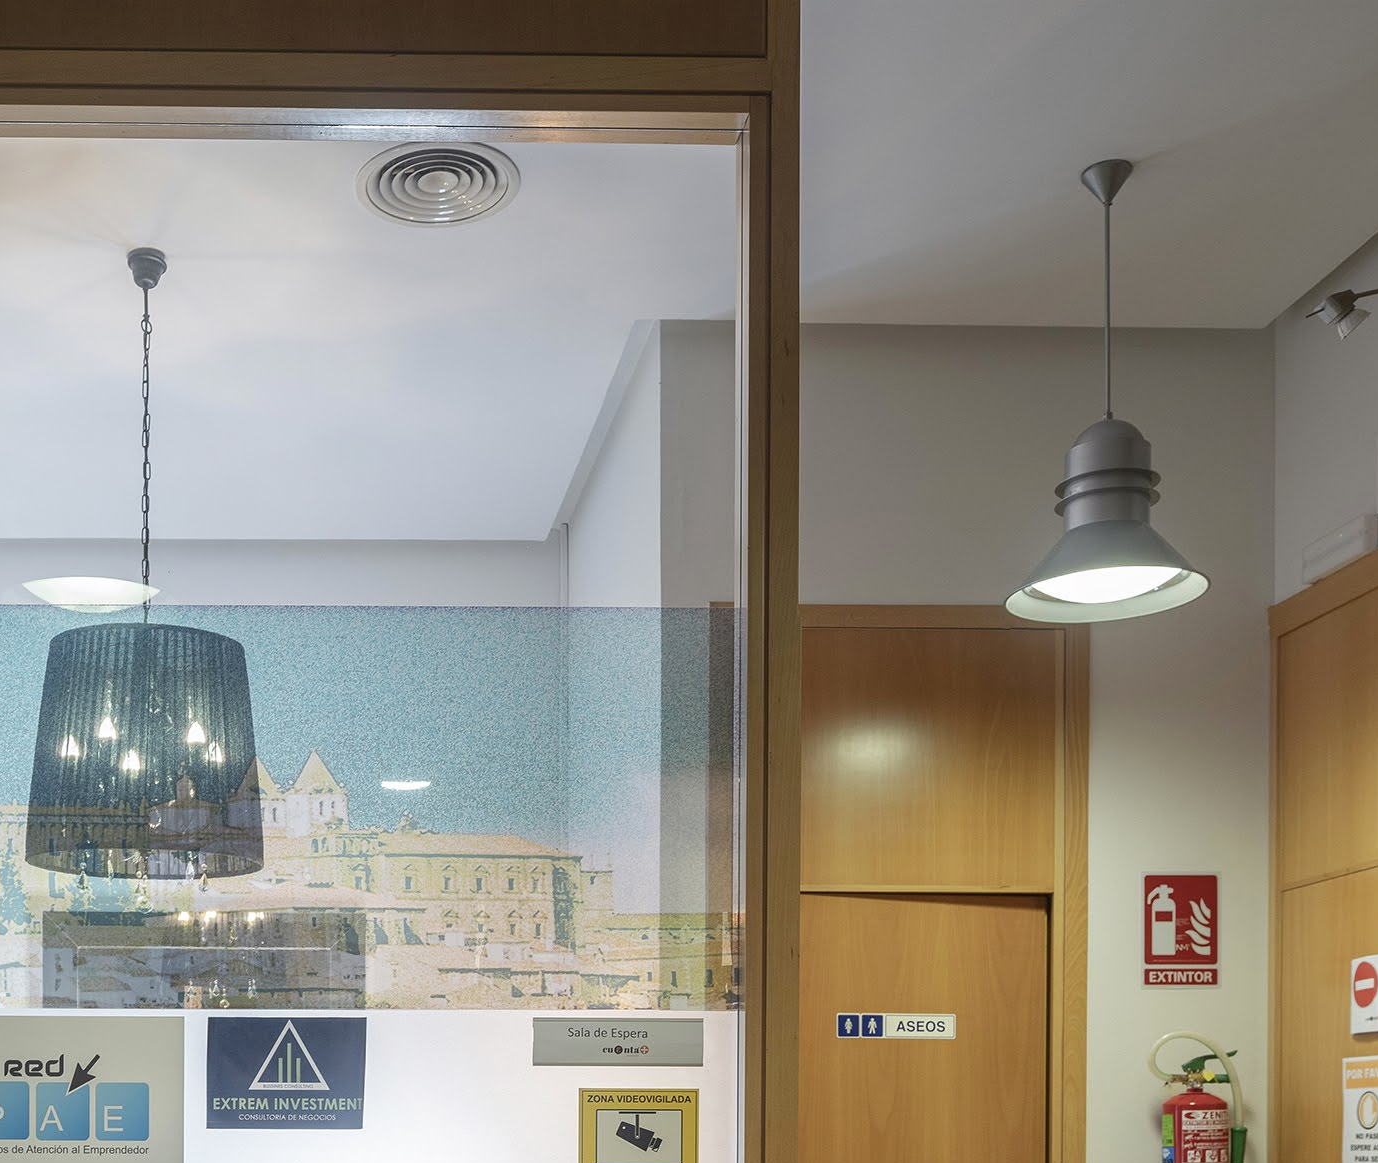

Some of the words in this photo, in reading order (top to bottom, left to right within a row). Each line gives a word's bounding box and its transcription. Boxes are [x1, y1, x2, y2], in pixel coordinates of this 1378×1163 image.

[1149, 971, 1213, 983] EXTINTOR
[896, 1021, 946, 1032] ASEOS
[568, 1027, 590, 1038] Sala
[594, 1027, 607, 1038] de
[611, 1028, 648, 1040] Espera
[1347, 1069, 1363, 1079] POR
[213, 1098, 269, 1110] EXTREM
[274, 1098, 363, 1111] INVESTMENT
[587, 1095, 614, 1103] ZONA
[617, 1095, 692, 1103] VIDEOVIGILADA
[11, 1145, 24, 1154] de
[26, 1145, 69, 1154] Atención
[71, 1145, 80, 1154] al
[83, 1145, 149, 1157] Emprendedor
